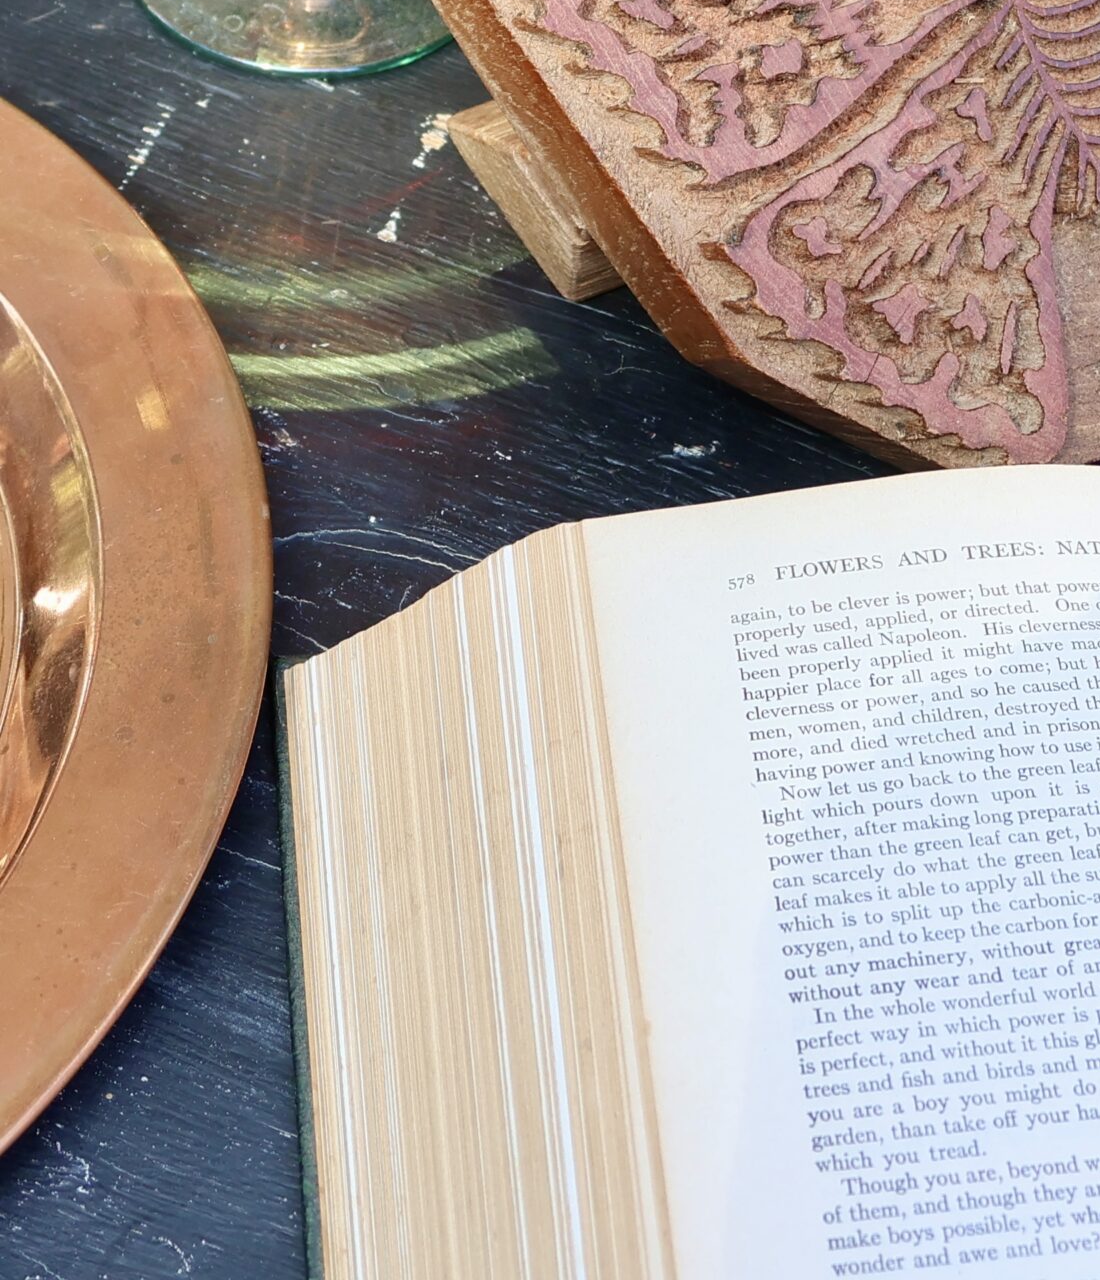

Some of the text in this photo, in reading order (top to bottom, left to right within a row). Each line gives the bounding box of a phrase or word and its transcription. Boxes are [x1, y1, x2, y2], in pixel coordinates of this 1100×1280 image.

[727, 572, 755, 590] 578
[774, 554, 884, 581] FLOWERS
[897, 547, 948, 567] AND
[960, 541, 1044, 560] TREES:
[729, 606, 782, 626] again,
[787, 604, 806, 617] to
[809, 599, 833, 614] be
[837, 595, 890, 611] clever
[895, 590, 910, 605] is
[914, 588, 974, 607] power;
[977, 582, 1010, 597] but
[1014, 580, 1051, 595] that
[735, 642, 780, 662] lived
[783, 642, 818, 656] was
[822, 632, 873, 652] called
[877, 626, 967, 647] Napoleon.
[981, 620, 1014, 636] His
[754, 763, 817, 783] having
[820, 759, 875, 779] power
[880, 751, 915, 770] and
[917, 745, 995, 766] knowing
[997, 742, 1035, 758] how
[1039, 741, 1059, 755] to
[1062, 740, 1092, 753] use
[787, 982, 863, 1004] without
[869, 979, 906, 997] any
[913, 974, 960, 990] wear
[967, 965, 1004, 985] and
[1011, 966, 1048, 981] tear
[1055, 958, 1074, 977] of
[812, 1006, 837, 1024] In
[842, 1002, 874, 1021] the
[879, 995, 936, 1017] whole
[941, 985, 1037, 1011] wonderful
[1041, 979, 1097, 1001] world
[814, 1138, 988, 1173] which you tread.
[830, 1231, 1100, 1277] wonder and awe and love?
